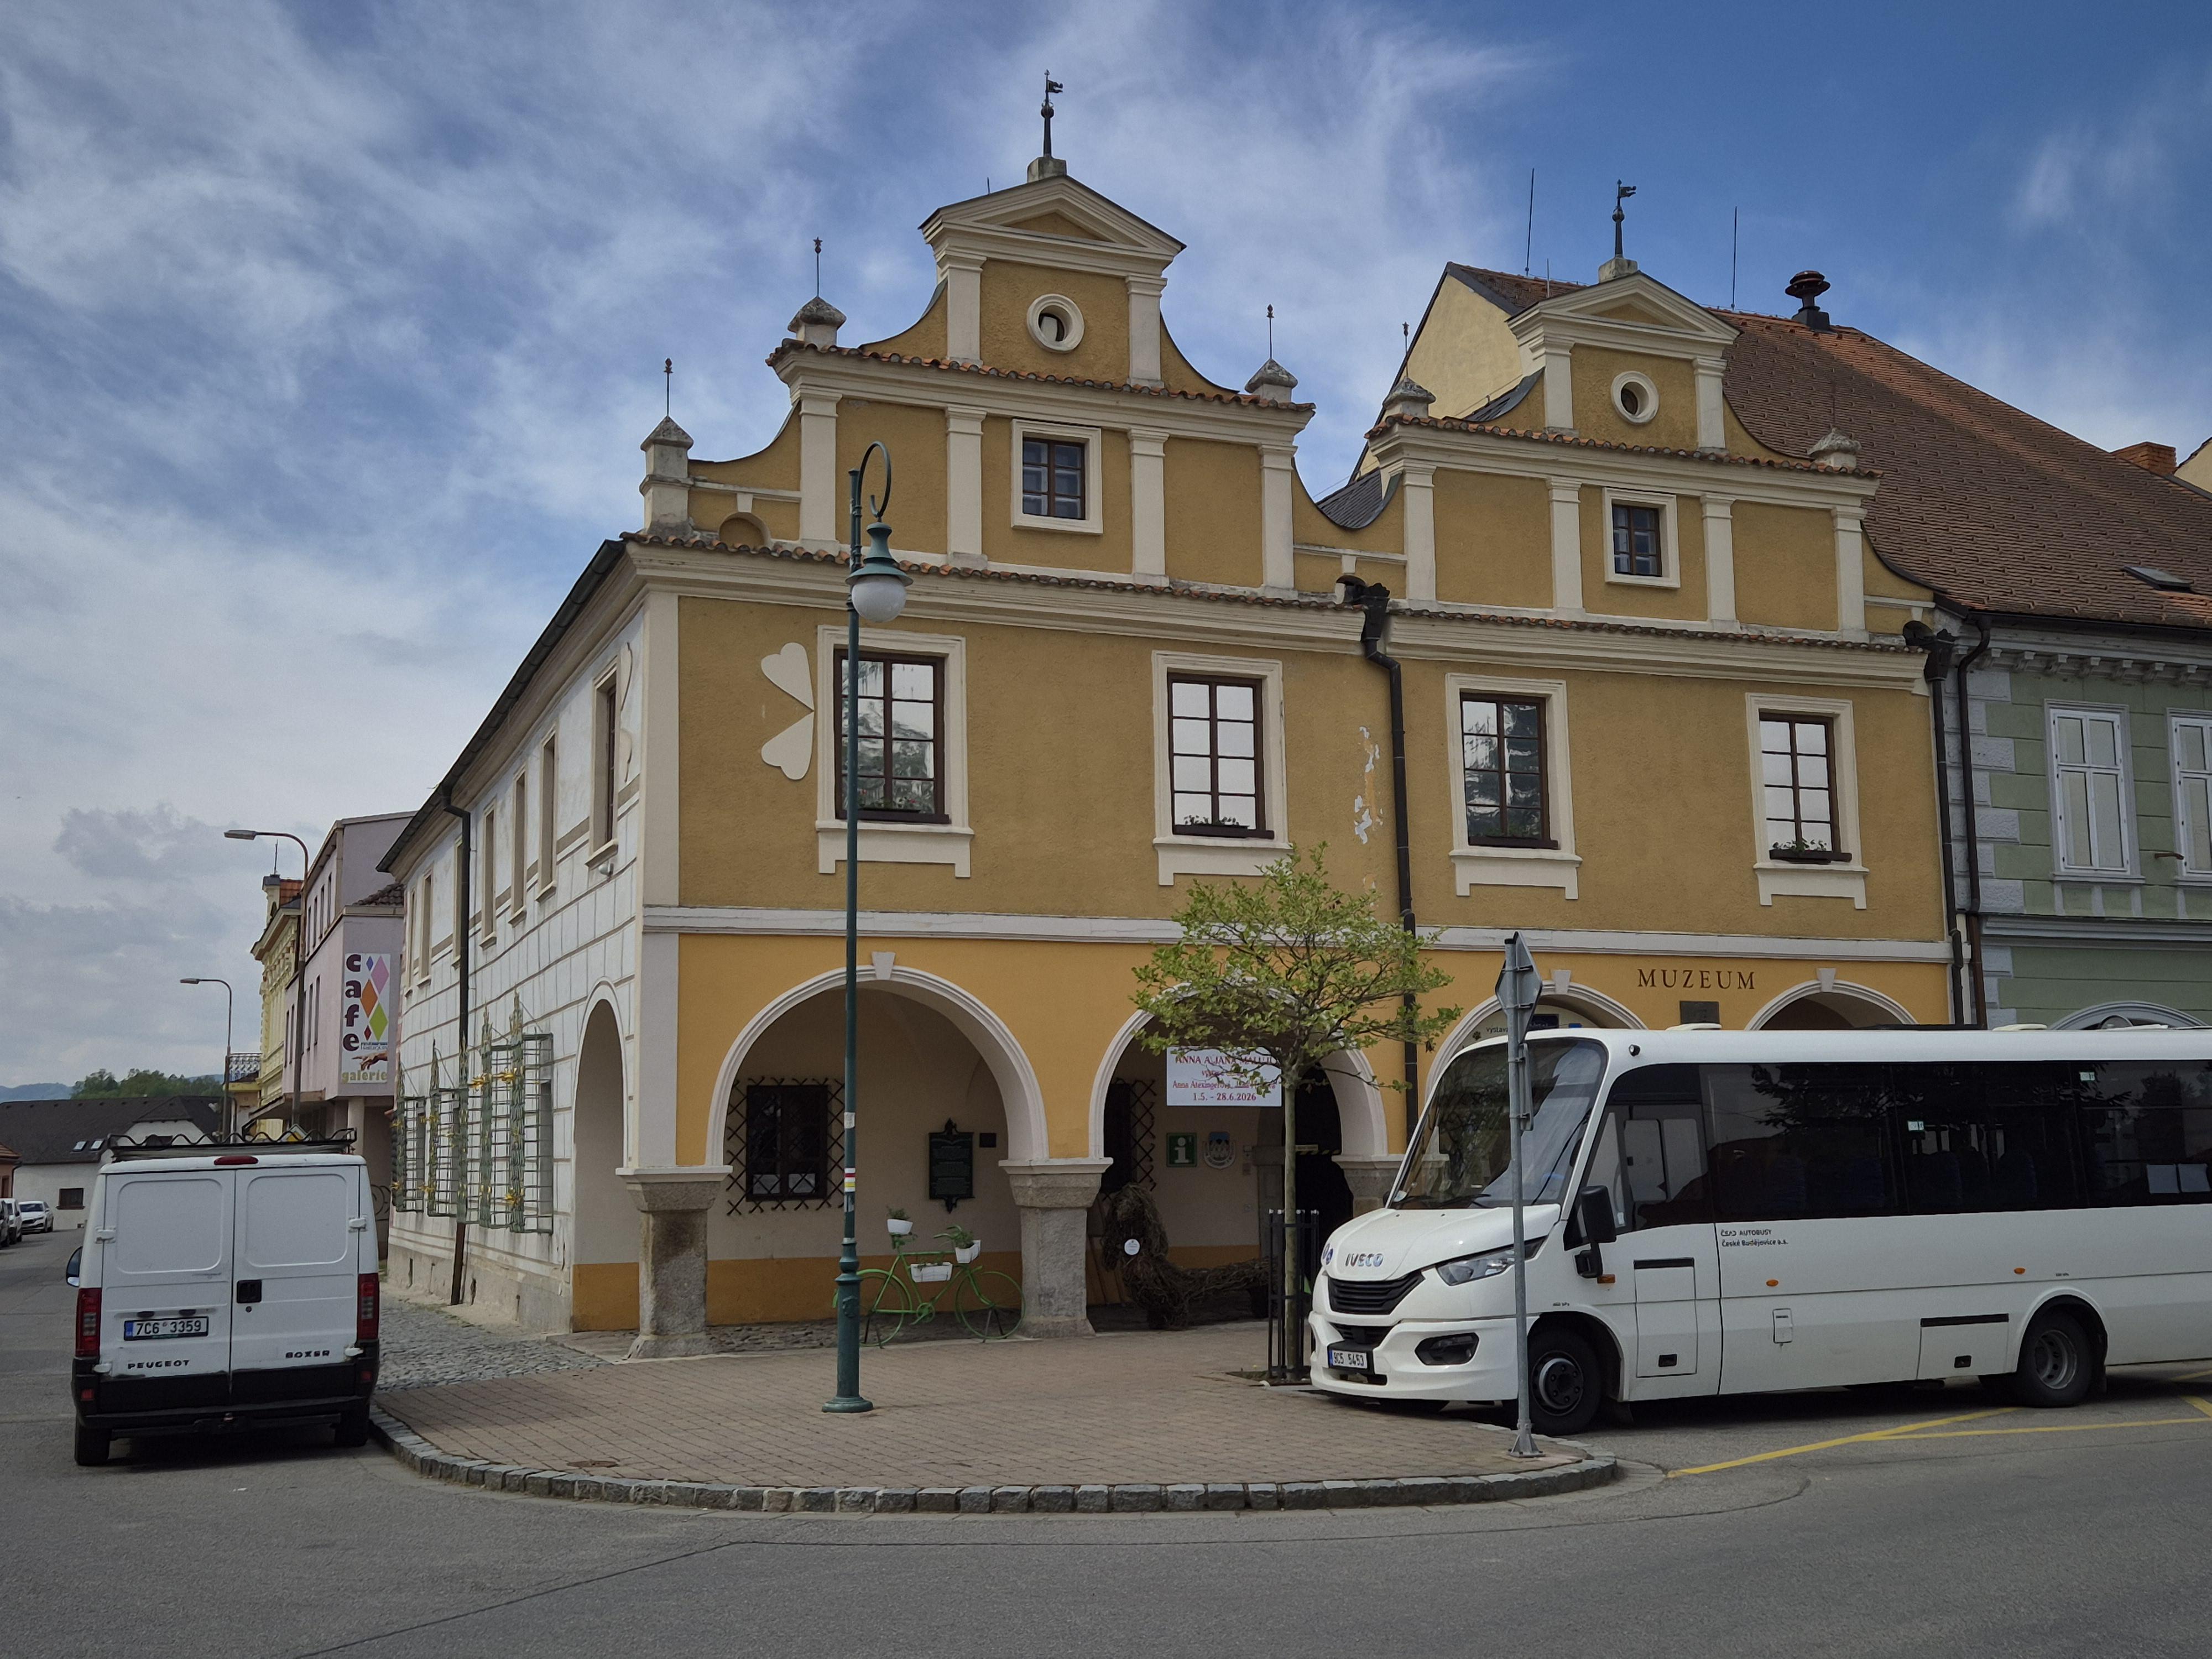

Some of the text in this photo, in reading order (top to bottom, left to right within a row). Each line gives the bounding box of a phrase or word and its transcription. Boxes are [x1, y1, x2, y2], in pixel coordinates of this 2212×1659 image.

[1637, 969, 1755, 990] MUZEUM
[343, 954, 361, 1051] cafe
[1176, 1056, 1202, 1065] ANNA
[341, 1070, 388, 1084] galerie
[1193, 1093, 1208, 1101] 1.5.
[1217, 1093, 1256, 1101] 28.6.2026
[1345, 1253, 1384, 1267] IVECO
[136, 1322, 160, 1335] 7C6
[170, 1320, 201, 1333] 3359
[285, 1350, 330, 1359] BOXER
[128, 1360, 190, 1369] PEUGEOT
